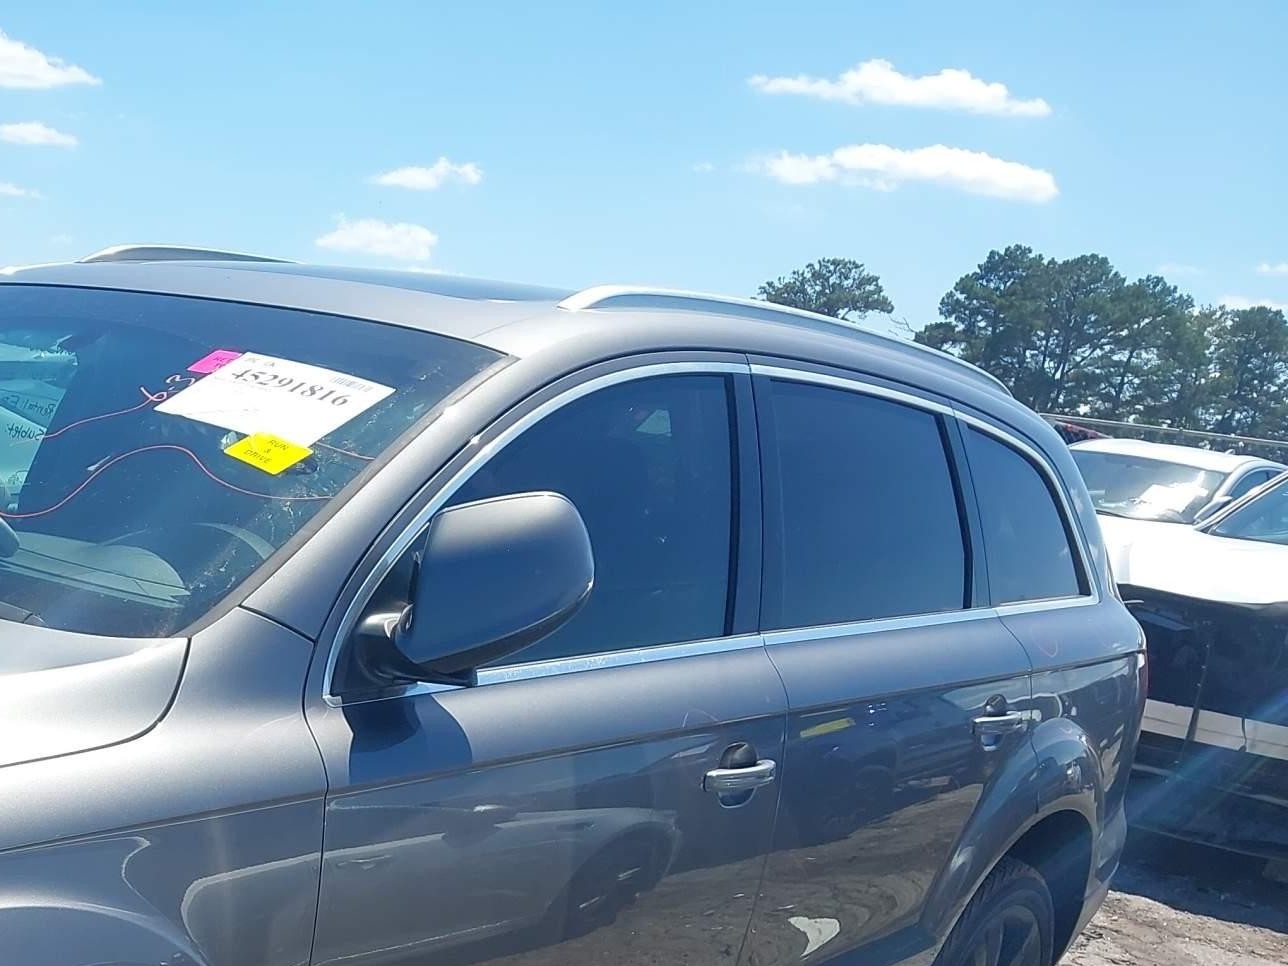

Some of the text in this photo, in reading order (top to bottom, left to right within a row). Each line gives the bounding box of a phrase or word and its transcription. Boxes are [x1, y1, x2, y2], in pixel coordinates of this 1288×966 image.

[231, 368, 349, 407] 45291816
[267, 439, 289, 451] RUN
[243, 449, 272, 464] DRIVE
